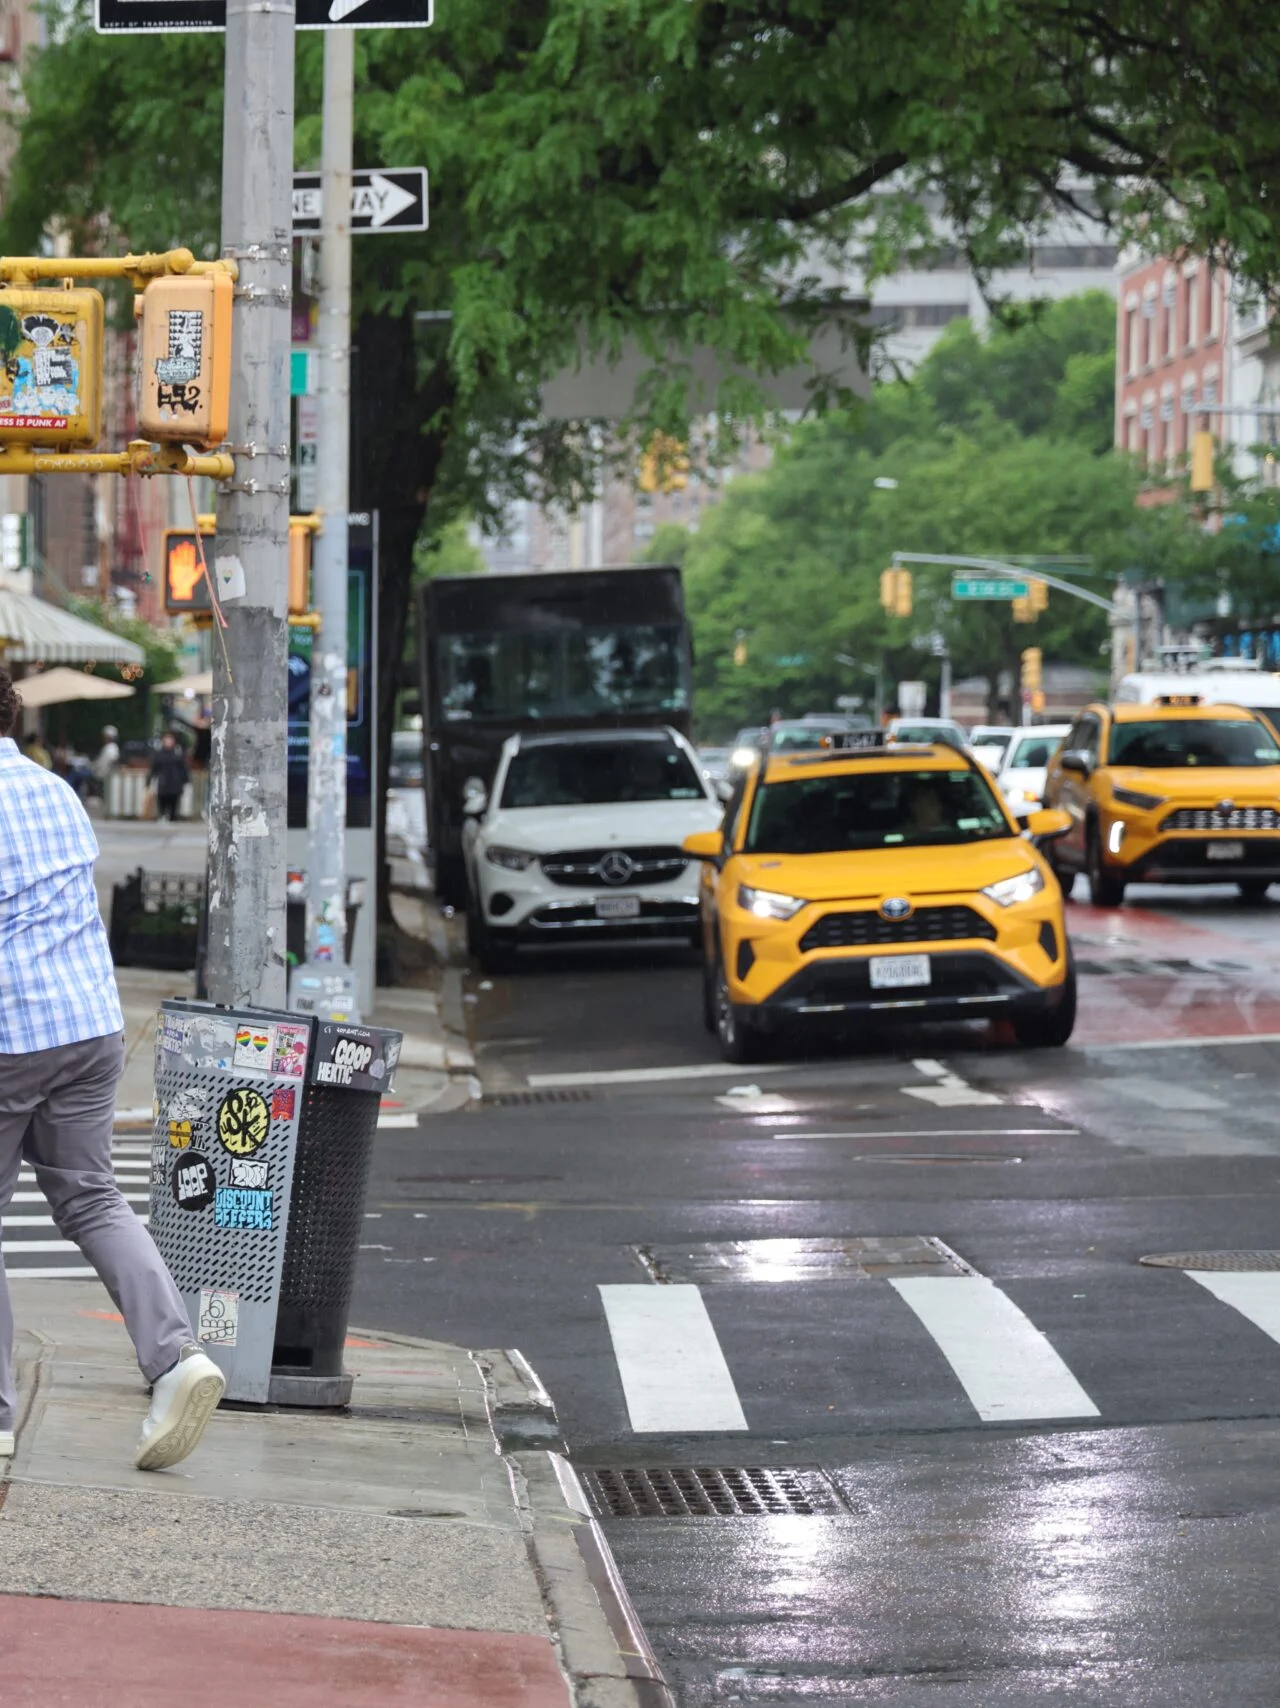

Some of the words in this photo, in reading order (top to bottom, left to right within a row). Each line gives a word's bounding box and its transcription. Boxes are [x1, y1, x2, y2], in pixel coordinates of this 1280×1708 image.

[16, 418, 24, 426] IS
[26, 418, 53, 427] PUNK
[54, 419, 67, 428] AF
[316, 1061, 354, 1085] HEKTIC
[215, 1188, 272, 1211] DISCOUNT
